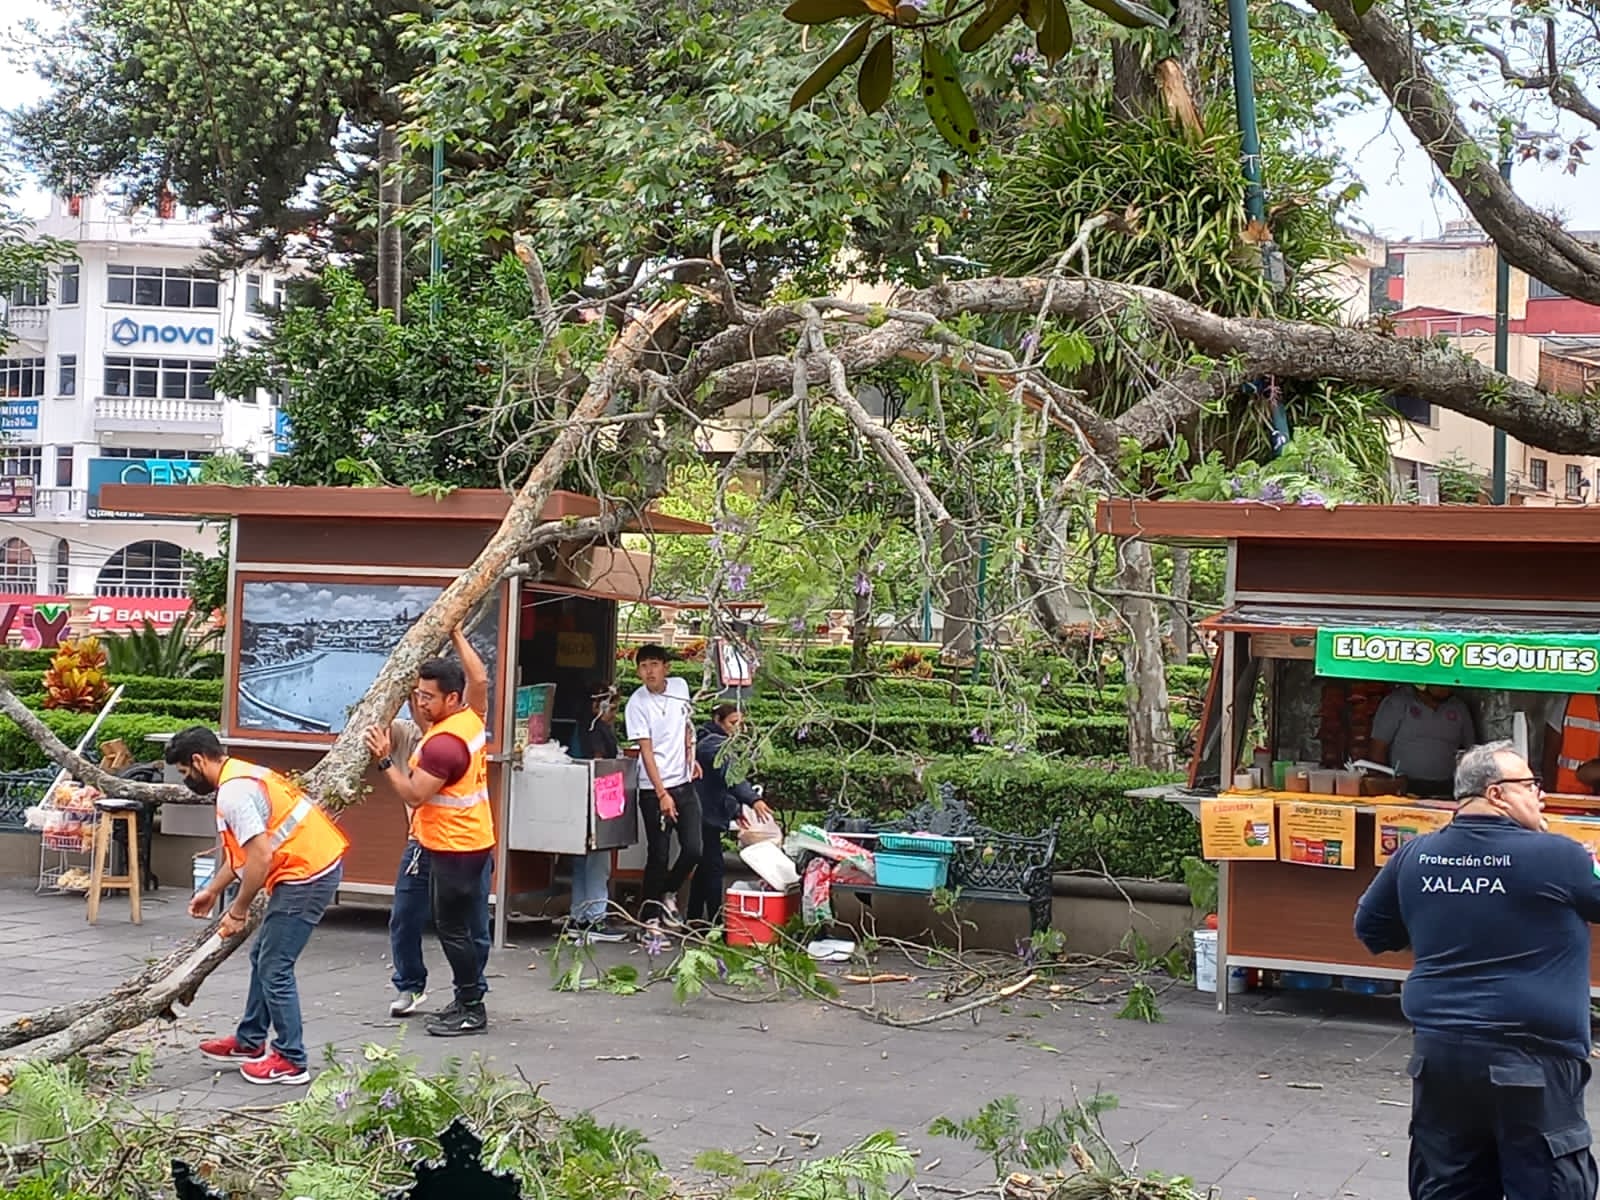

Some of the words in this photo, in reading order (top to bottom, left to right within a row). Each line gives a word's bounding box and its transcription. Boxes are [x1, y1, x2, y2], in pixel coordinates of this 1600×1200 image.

[142, 325, 214, 344] nova
[1336, 636, 1432, 662] ELOTES
[1439, 646, 1457, 666] Y
[1465, 645, 1597, 673] ESQUITES
[1418, 854, 1481, 867] Protección
[1483, 855, 1511, 867] Civil
[1421, 876, 1506, 894] XALAPA
